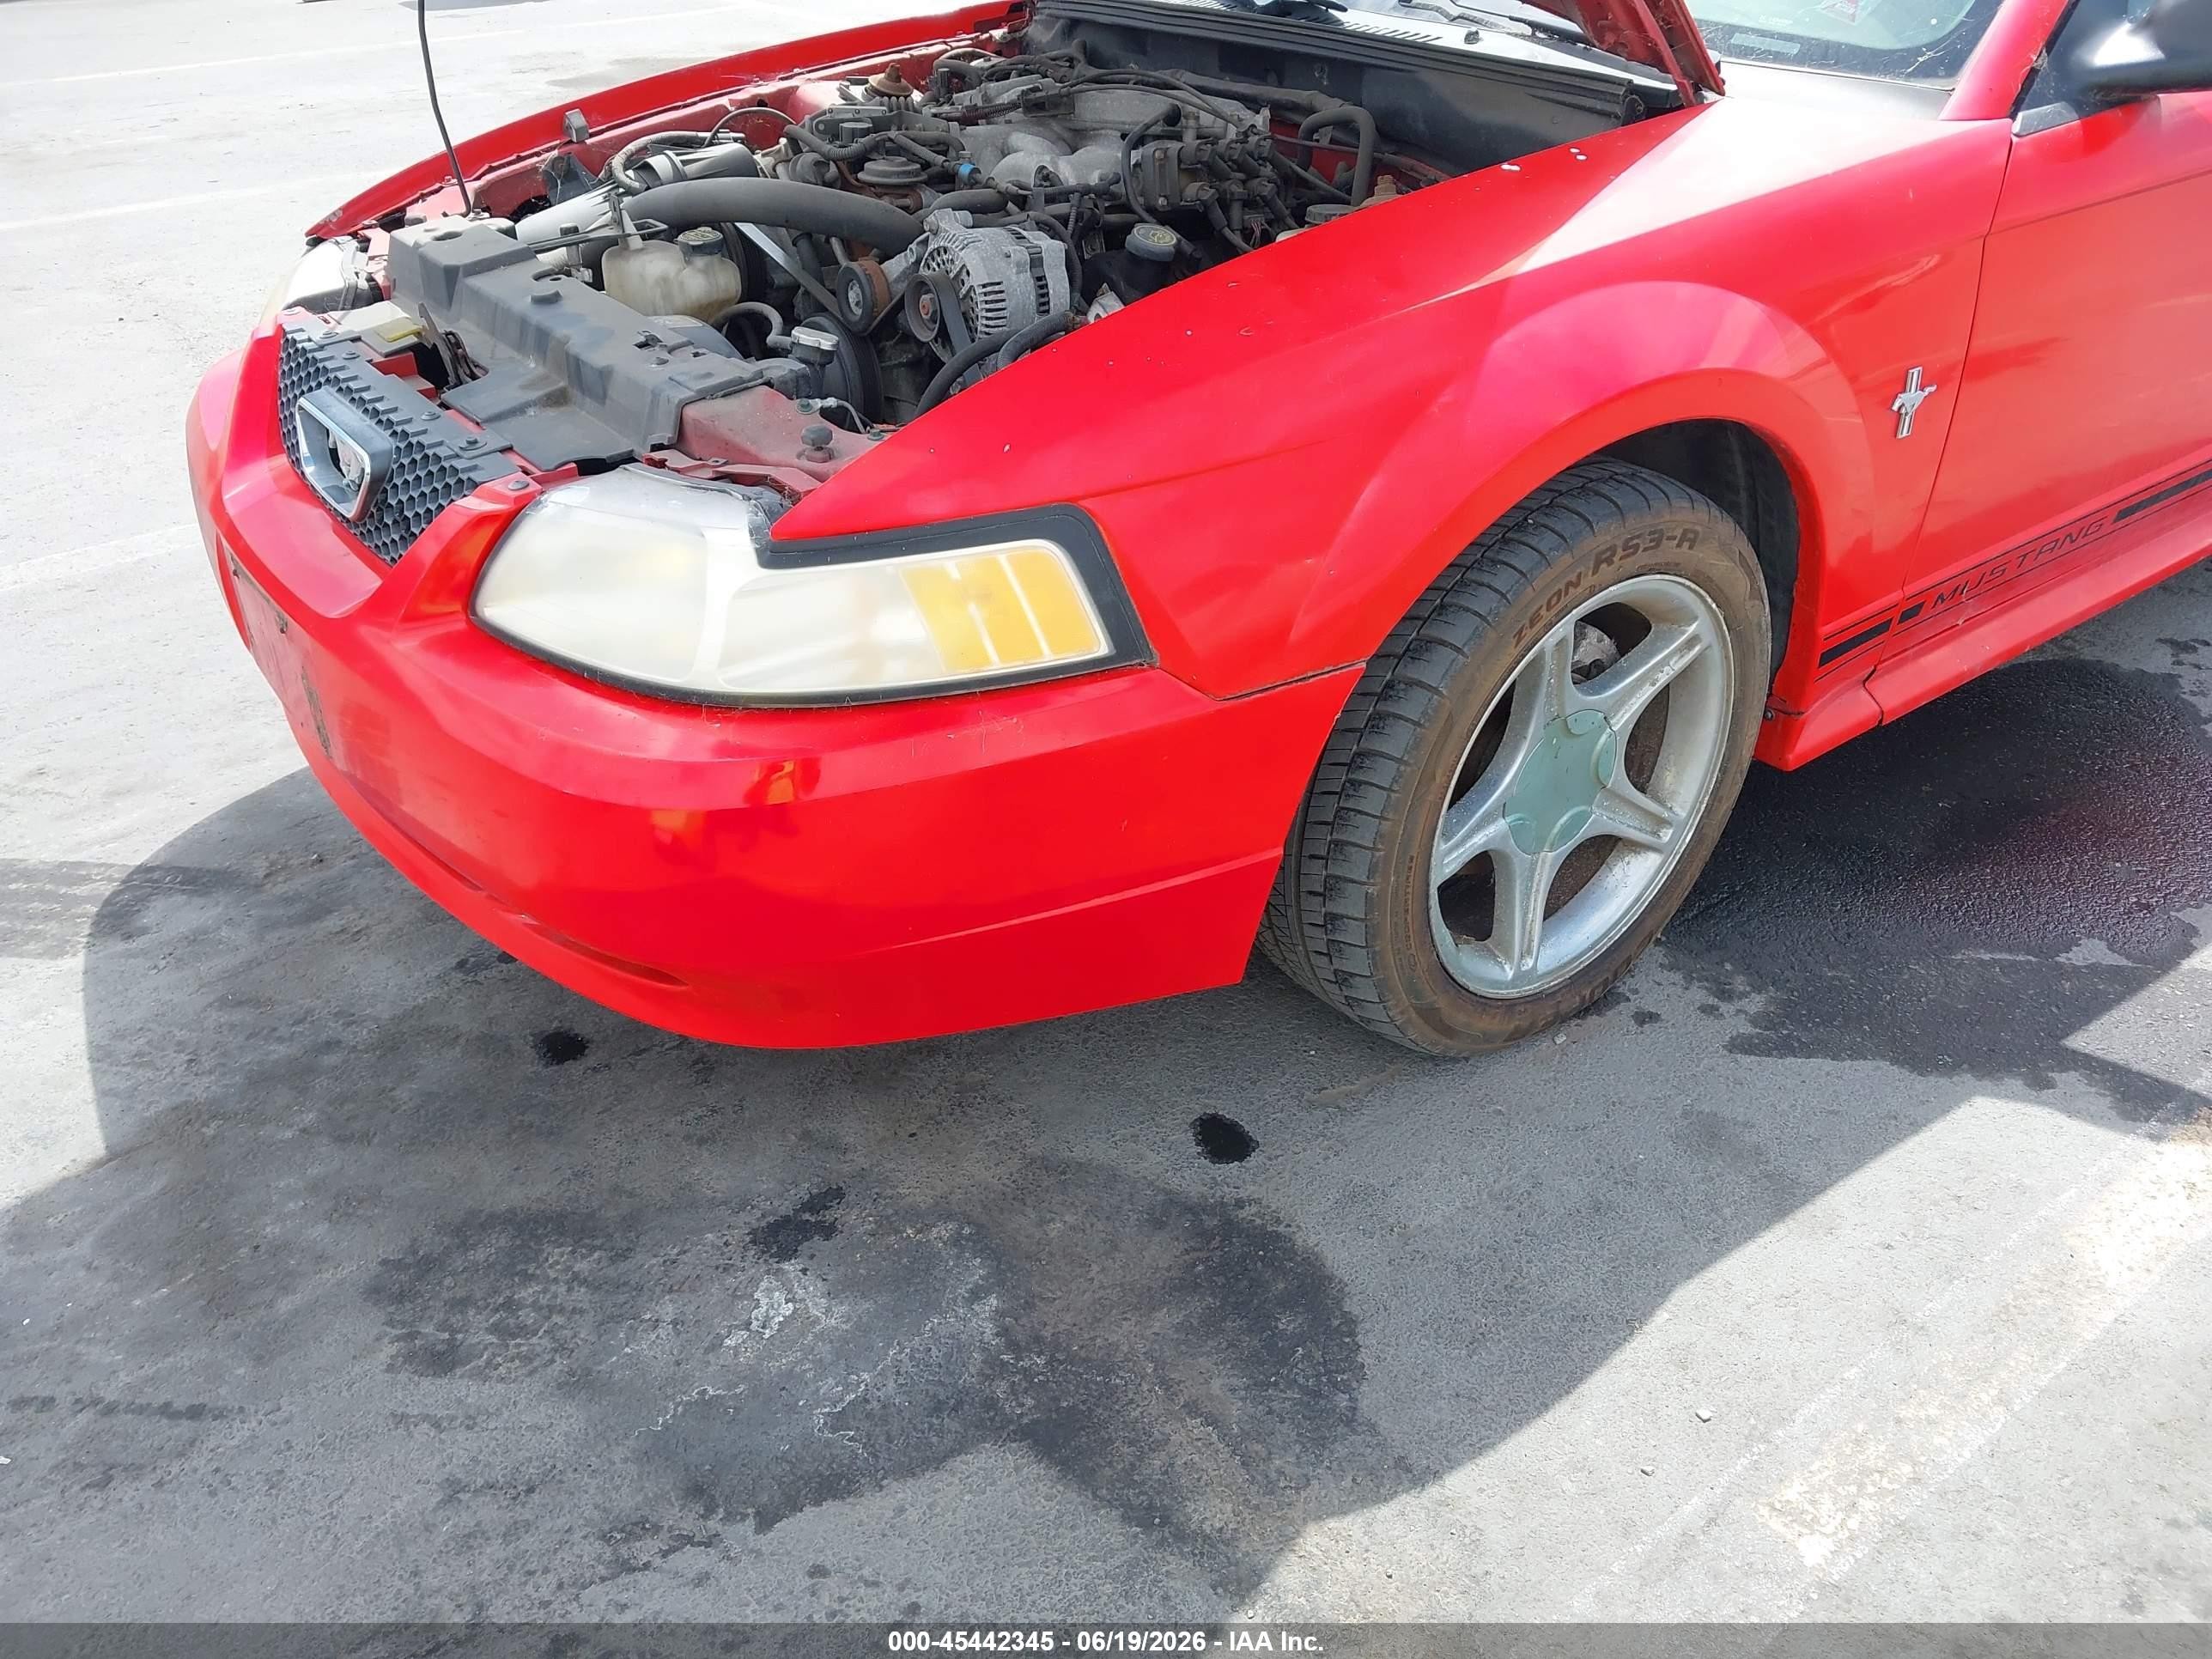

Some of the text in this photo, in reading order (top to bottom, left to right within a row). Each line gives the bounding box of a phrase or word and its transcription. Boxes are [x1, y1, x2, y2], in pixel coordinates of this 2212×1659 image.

[1512, 527, 1701, 649] ZEON RS3-A
[1930, 515, 2108, 610] MUSTANG
